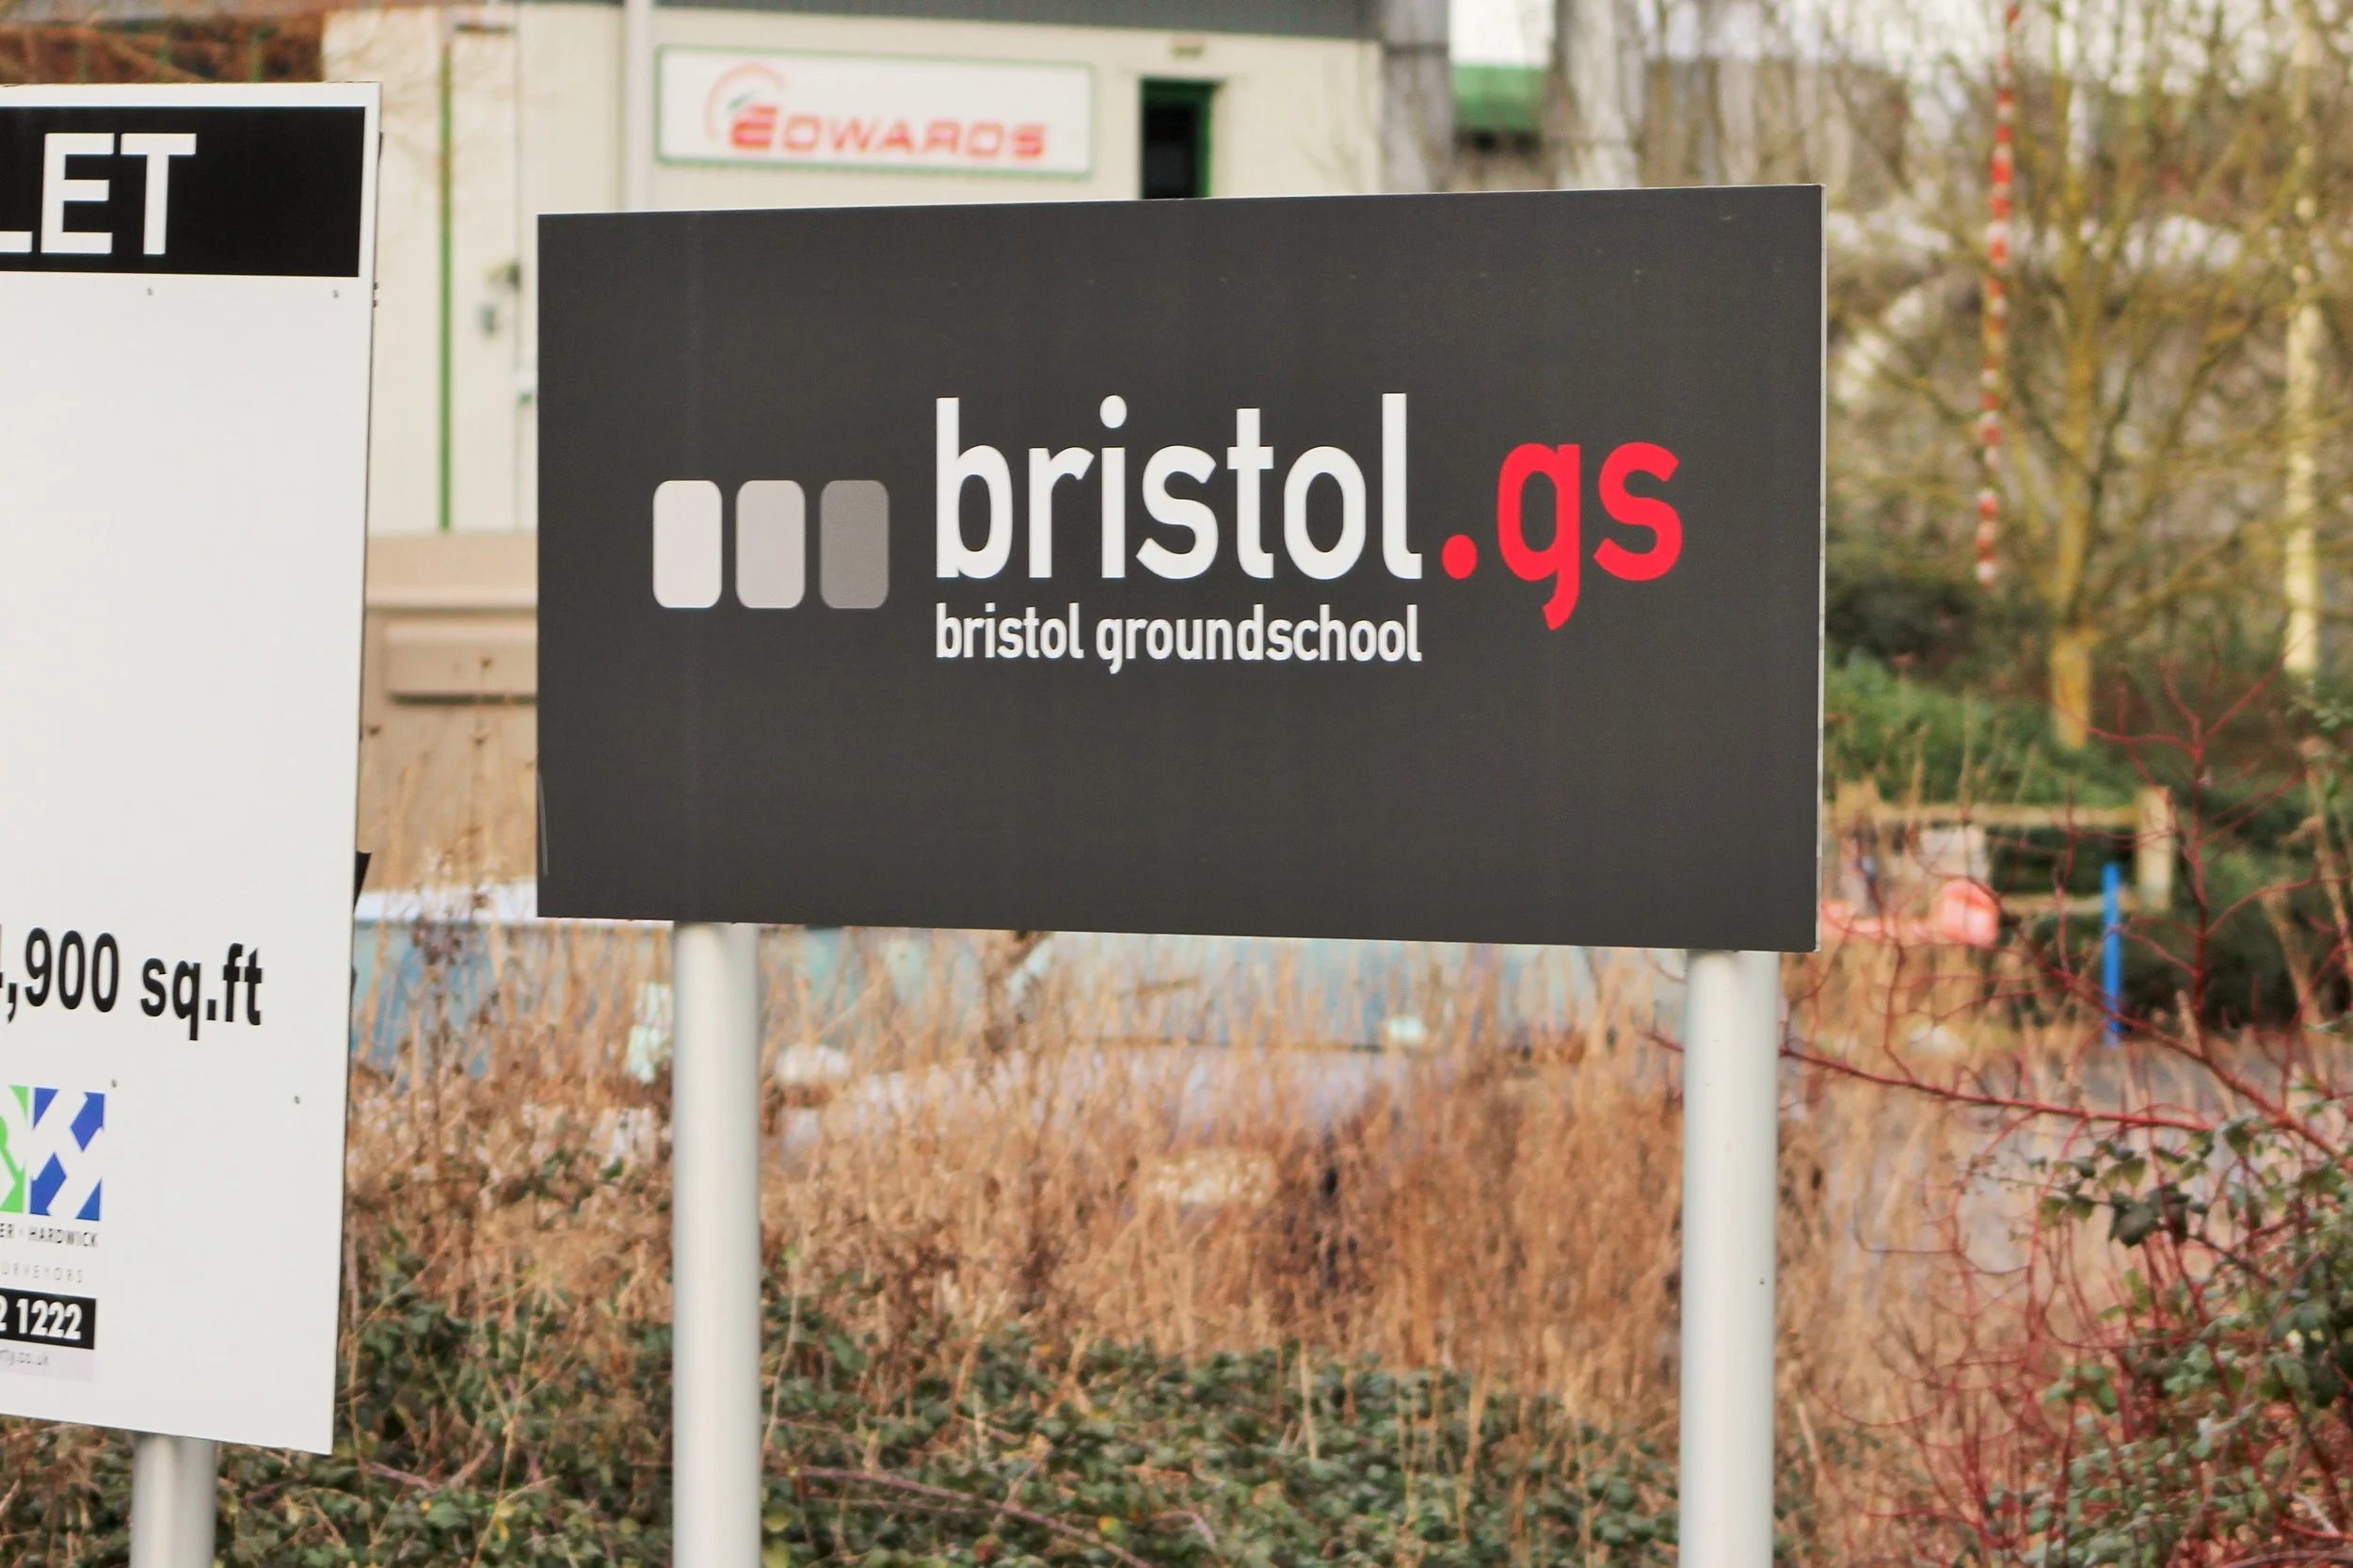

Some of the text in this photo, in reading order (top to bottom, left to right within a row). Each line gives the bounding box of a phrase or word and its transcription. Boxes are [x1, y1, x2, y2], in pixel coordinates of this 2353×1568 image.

[728, 104, 1048, 161] EDWARDS
[936, 602, 1423, 675] bristol groundschool
[0, 926, 263, 1041] ,900 sq.ft
[27, 1225, 99, 1248] HARDWICK
[16, 1298, 82, 1340] 1222
